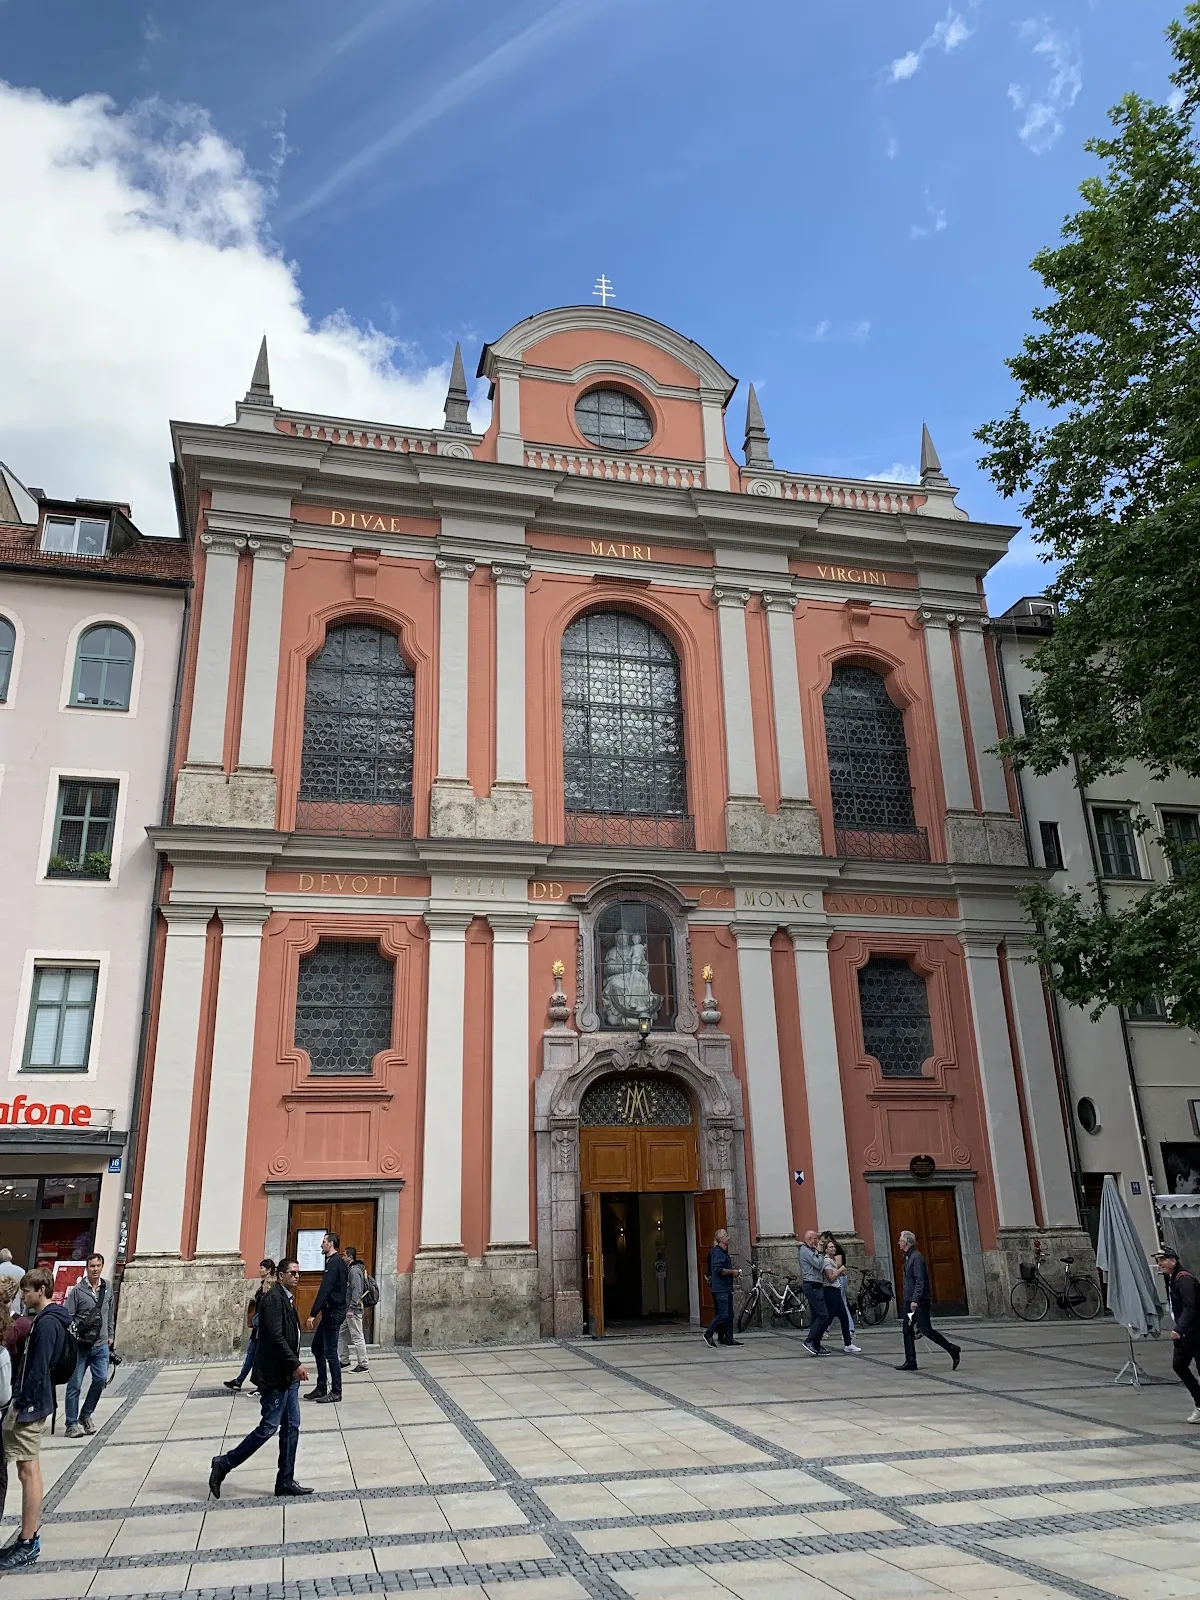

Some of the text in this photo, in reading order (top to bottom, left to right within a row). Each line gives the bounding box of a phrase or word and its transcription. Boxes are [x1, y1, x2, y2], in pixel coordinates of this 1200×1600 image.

[330, 511, 887, 586] DIVAE MATRI VIRGINI
[298, 873, 398, 894] DEVOTI
[453, 878, 505, 897] FILII
[532, 882, 564, 899] DD
[699, 889, 730, 906] CC
[743, 889, 816, 908] MONAC
[111, 1158, 120, 1167] 16
